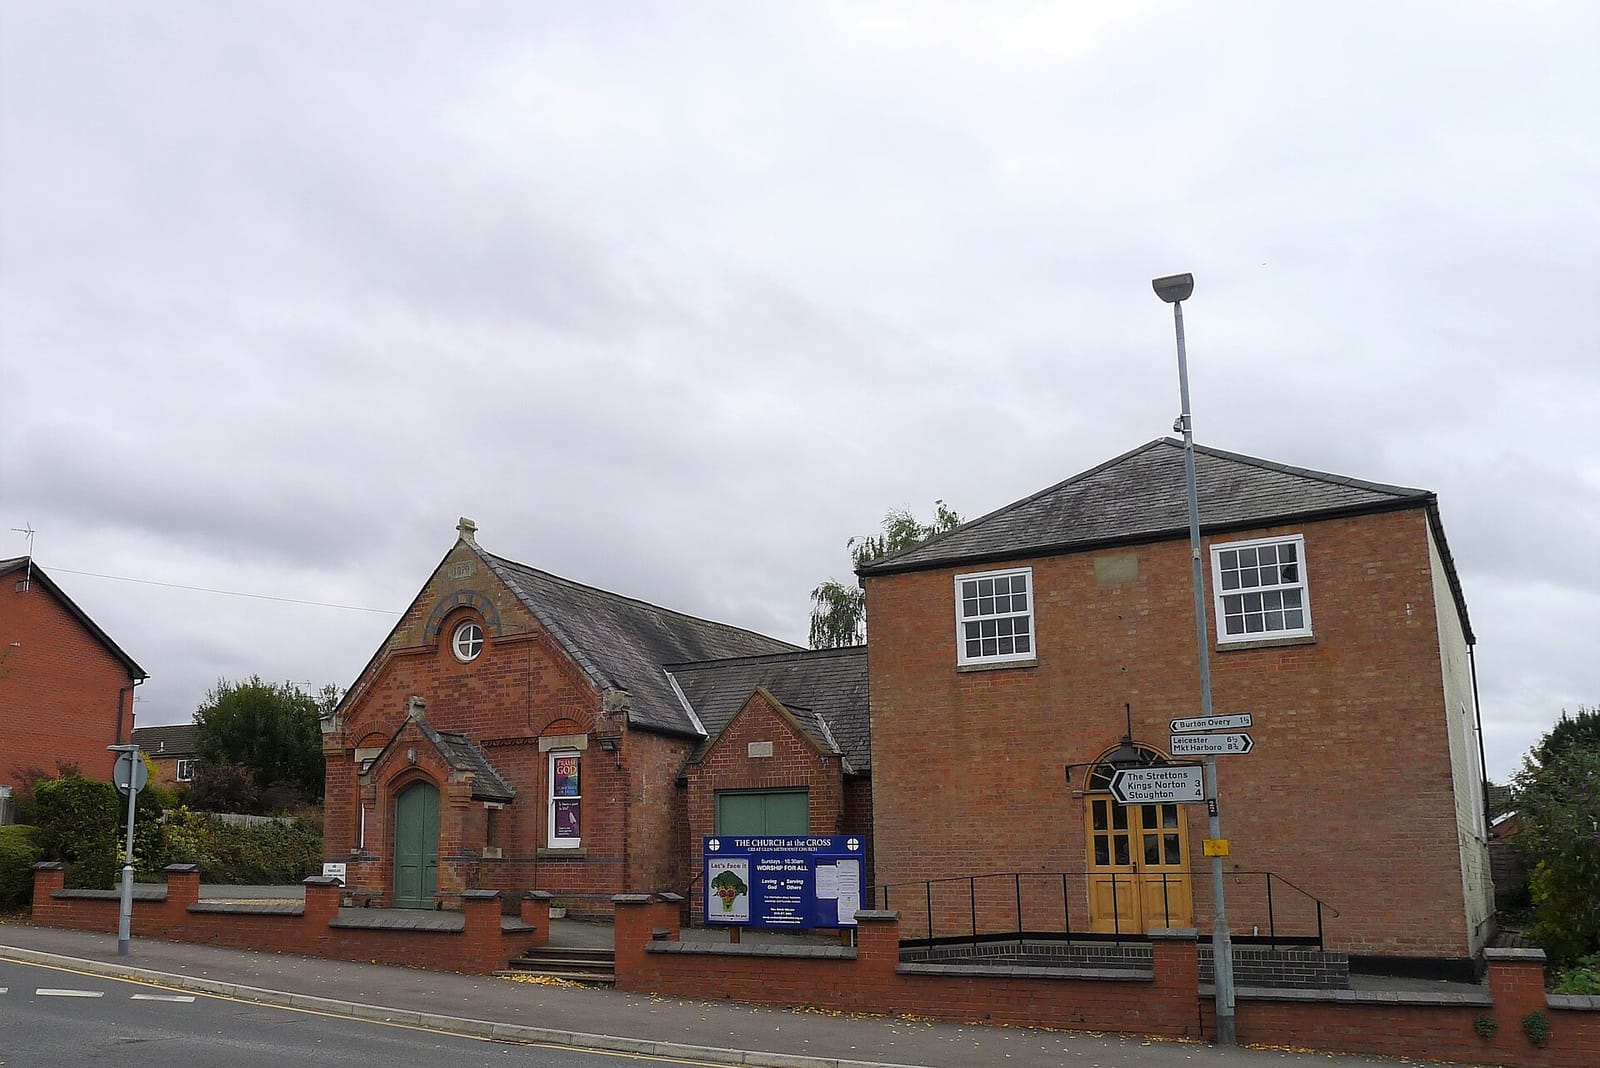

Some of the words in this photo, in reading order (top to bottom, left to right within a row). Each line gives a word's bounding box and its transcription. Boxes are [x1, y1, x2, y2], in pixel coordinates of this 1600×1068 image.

[557, 765, 577, 775] GOD
[1146, 772, 1188, 780] Strettons
[1128, 782, 1152, 790] Kings
[1154, 781, 1186, 789] Norton
[1194, 780, 1201, 788] 3
[1129, 791, 1174, 799] Stoughton
[734, 839, 751, 847] THE
[751, 839, 785, 847] CHURCH
[794, 839, 805, 847] the
[806, 838, 831, 847] CROSS
